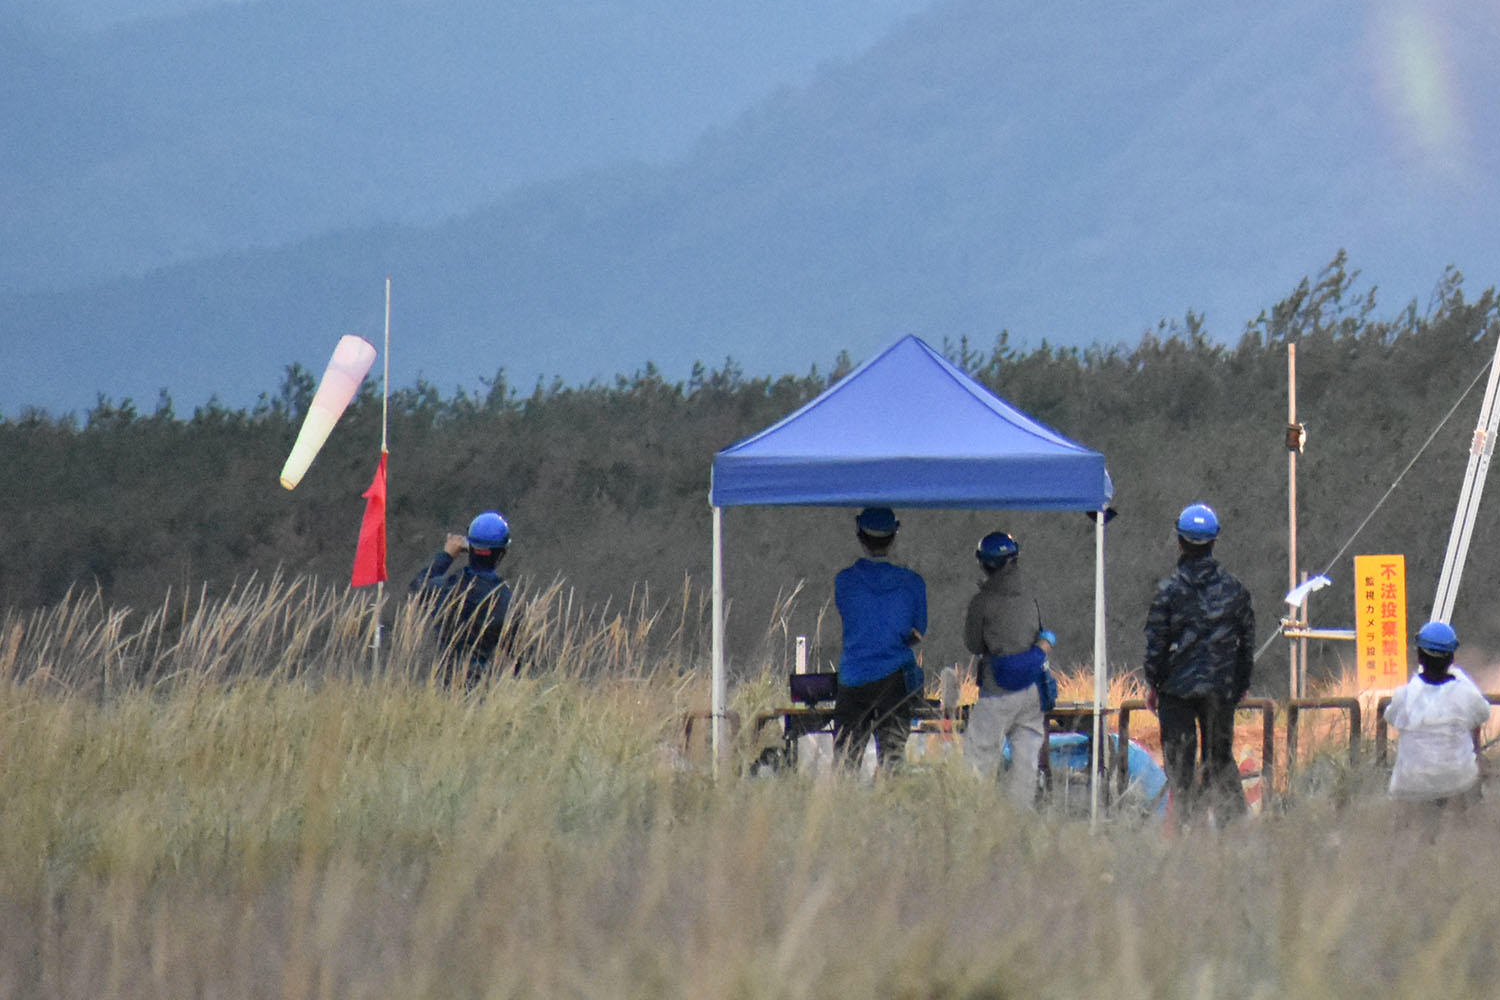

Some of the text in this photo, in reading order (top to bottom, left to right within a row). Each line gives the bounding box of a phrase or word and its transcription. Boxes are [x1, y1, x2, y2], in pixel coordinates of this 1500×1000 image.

[1381, 564, 1398, 675] 不法投棄禁止
